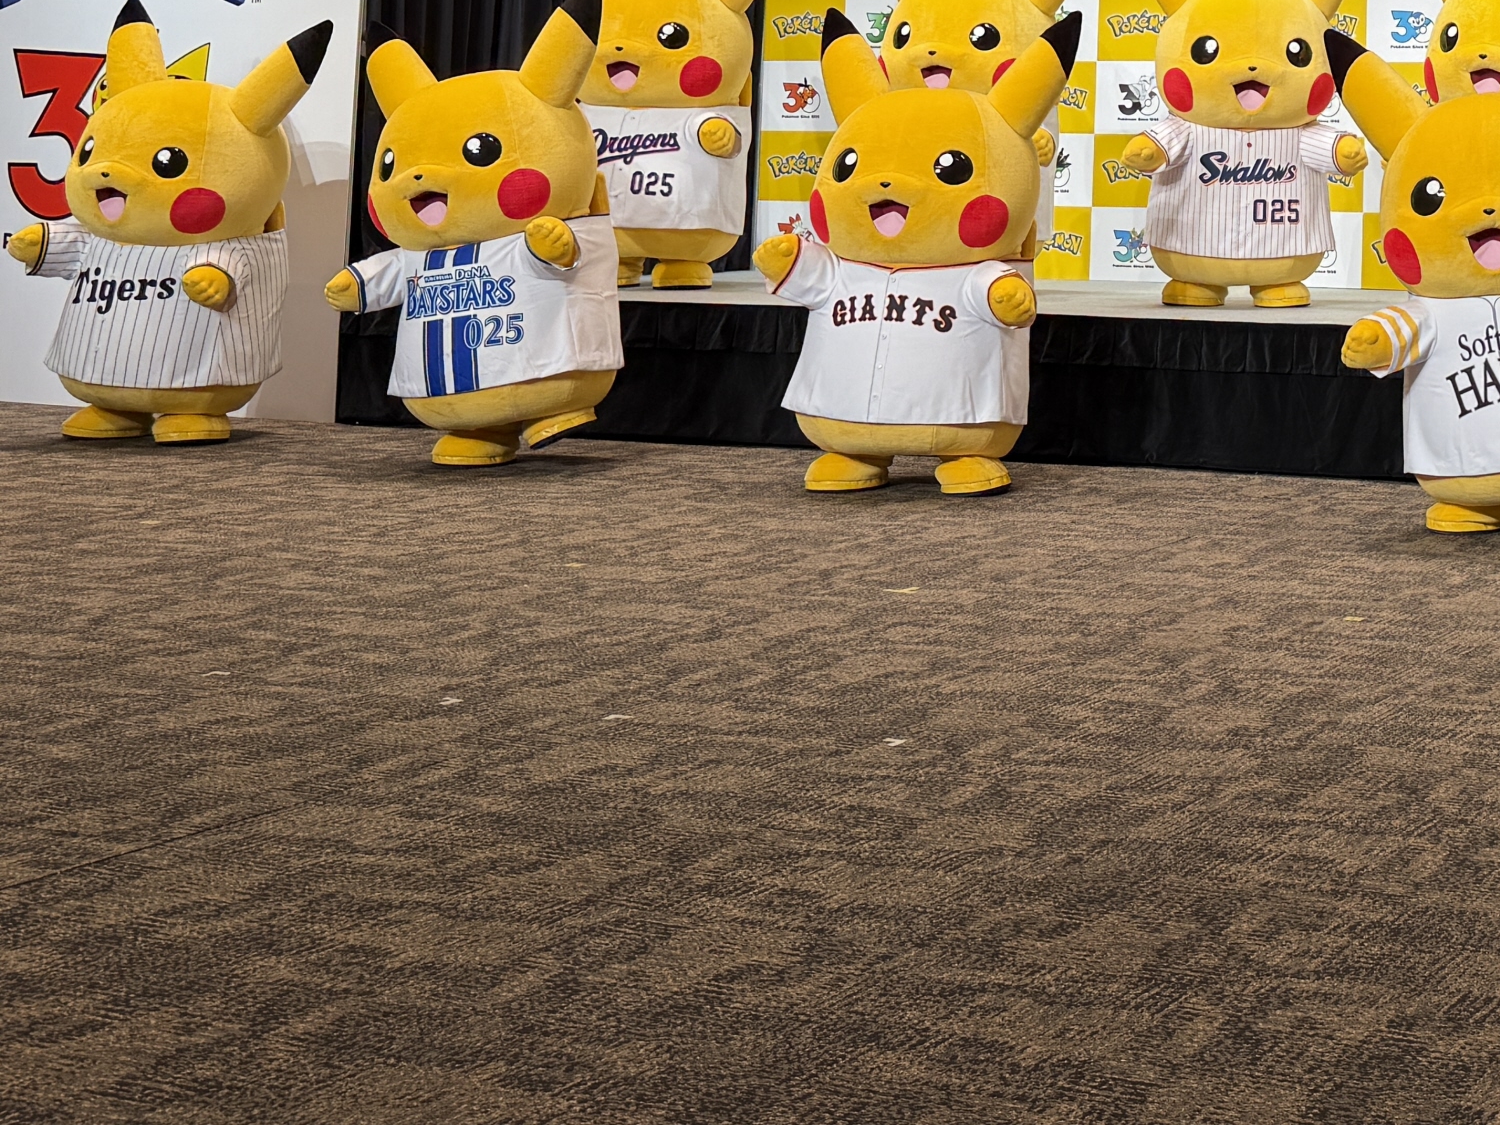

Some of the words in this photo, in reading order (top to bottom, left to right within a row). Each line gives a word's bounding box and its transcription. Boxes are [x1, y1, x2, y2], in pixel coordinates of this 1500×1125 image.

[1106, 10, 1166, 37] Pokém
[592, 128, 681, 167] Dragons
[630, 170, 676, 197] 025
[1199, 150, 1297, 186] Swallows
[1252, 198, 1300, 224] 025
[71, 267, 177, 315] Tigers
[455, 265, 491, 281] DeNA
[831, 292, 958, 333] GIANTS
[463, 313, 524, 350] 025
